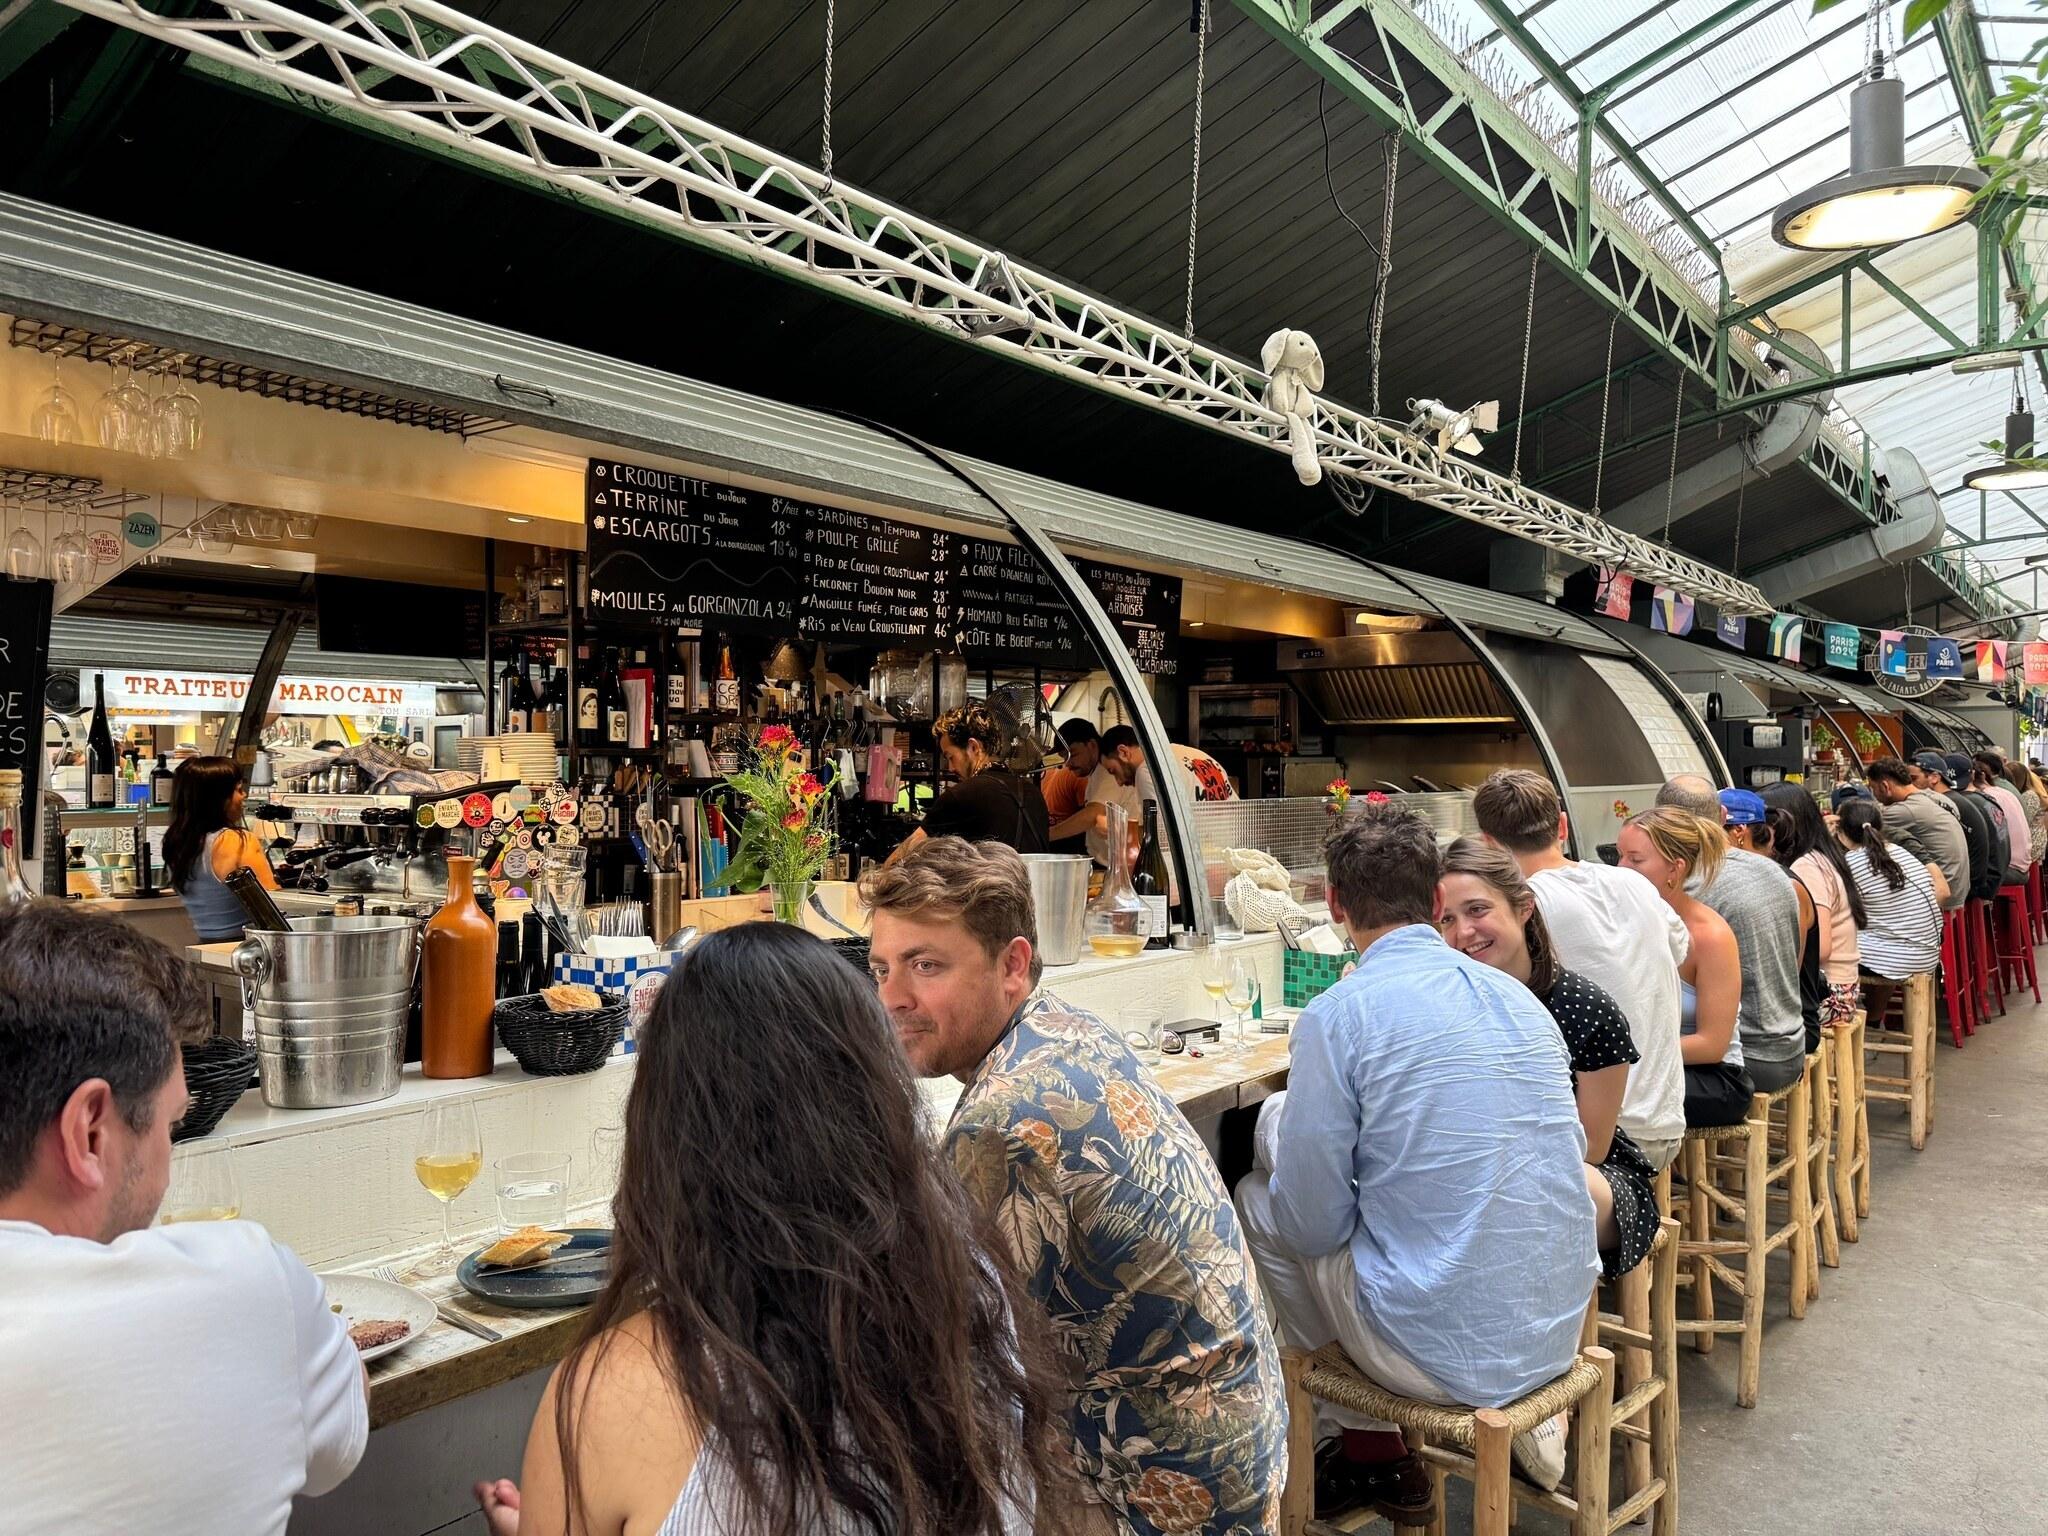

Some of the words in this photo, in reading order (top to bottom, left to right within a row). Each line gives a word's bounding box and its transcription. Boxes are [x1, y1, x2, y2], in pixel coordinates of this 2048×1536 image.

[613, 465, 711, 498] CROQUETTE
[609, 489, 690, 518] TERRINE
[703, 513, 716, 522] DU
[718, 512, 739, 527] JOUR
[128, 521, 156, 536] ZAZEN
[609, 516, 712, 546] ESCARGOTS
[881, 520, 921, 540] TEMPURA
[817, 528, 860, 549] POULPE
[974, 543, 1004, 563] FAUX
[837, 560, 849, 571] DE
[850, 558, 881, 575] COCHON
[972, 564, 998, 578] CARRÉ
[813, 573, 860, 593] ENCORNET
[601, 591, 666, 612] MOULES
[671, 603, 685, 613] AU
[688, 594, 774, 619] GORGONZOLA
[809, 593, 853, 611] ANGUILLE
[909, 606, 929, 619] GRAS
[1107, 602, 1144, 617] ARDOISES
[967, 607, 1002, 625] HOMARD
[830, 622, 841, 632] DE
[841, 617, 866, 633] VEAU
[869, 618, 927, 636] CROUSTILLANT
[1138, 629, 1149, 640] SEE
[1724, 623, 1739, 635] PARIS
[966, 627, 991, 647] CÔTE
[995, 632, 1006, 647] DE
[1009, 633, 1036, 648] BOEUF
[1137, 639, 1164, 651] SPECIALS
[1830, 635, 1855, 648] PARIS
[1830, 645, 1854, 657] 2024
[1935, 658, 1955, 667] PARIS
[124, 676, 248, 699] TRAITEU
[278, 683, 403, 705] MAROCAIN
[379, 706, 399, 716] TOM
[647, 978, 657, 987] LES
